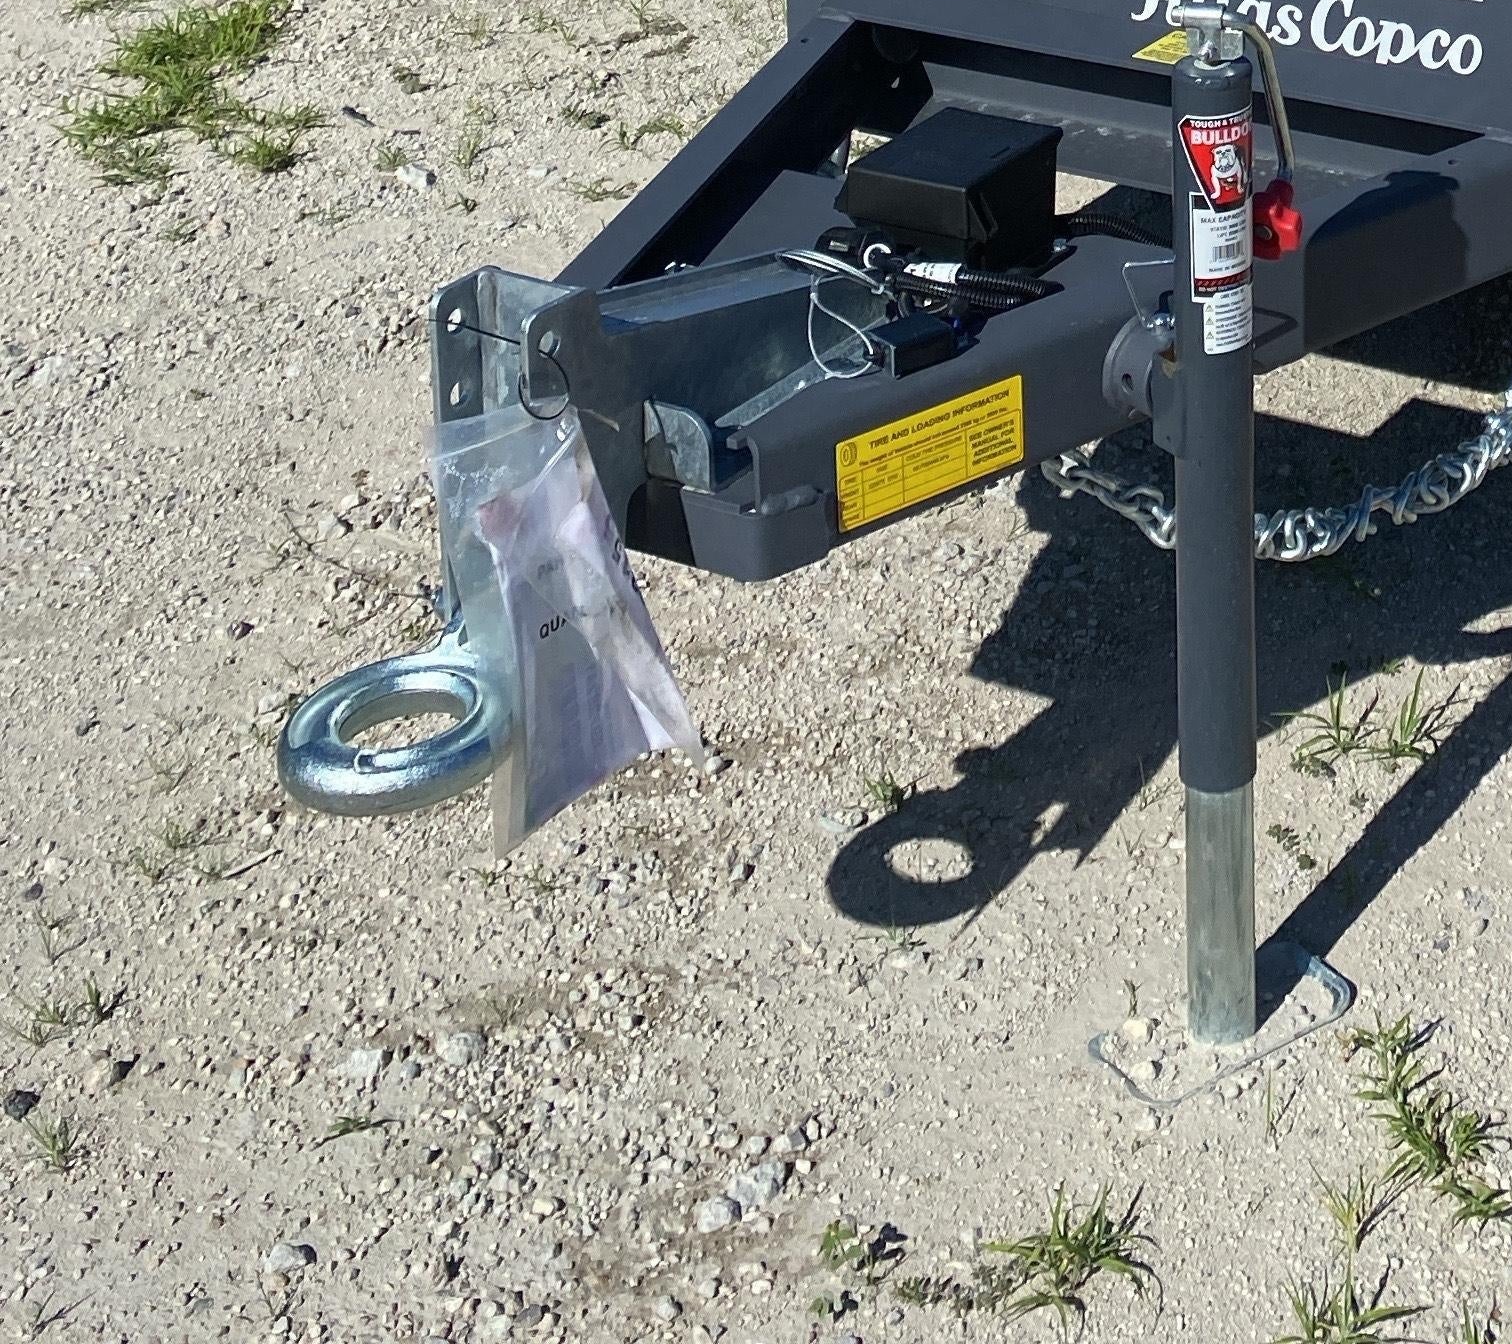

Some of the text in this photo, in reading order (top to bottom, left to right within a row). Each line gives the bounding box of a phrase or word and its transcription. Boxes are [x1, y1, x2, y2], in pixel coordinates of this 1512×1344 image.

[869, 436, 888, 449] TIRE
[890, 428, 909, 441] AND
[911, 412, 950, 434] LOADING
[952, 390, 1009, 417] INFORMATION
